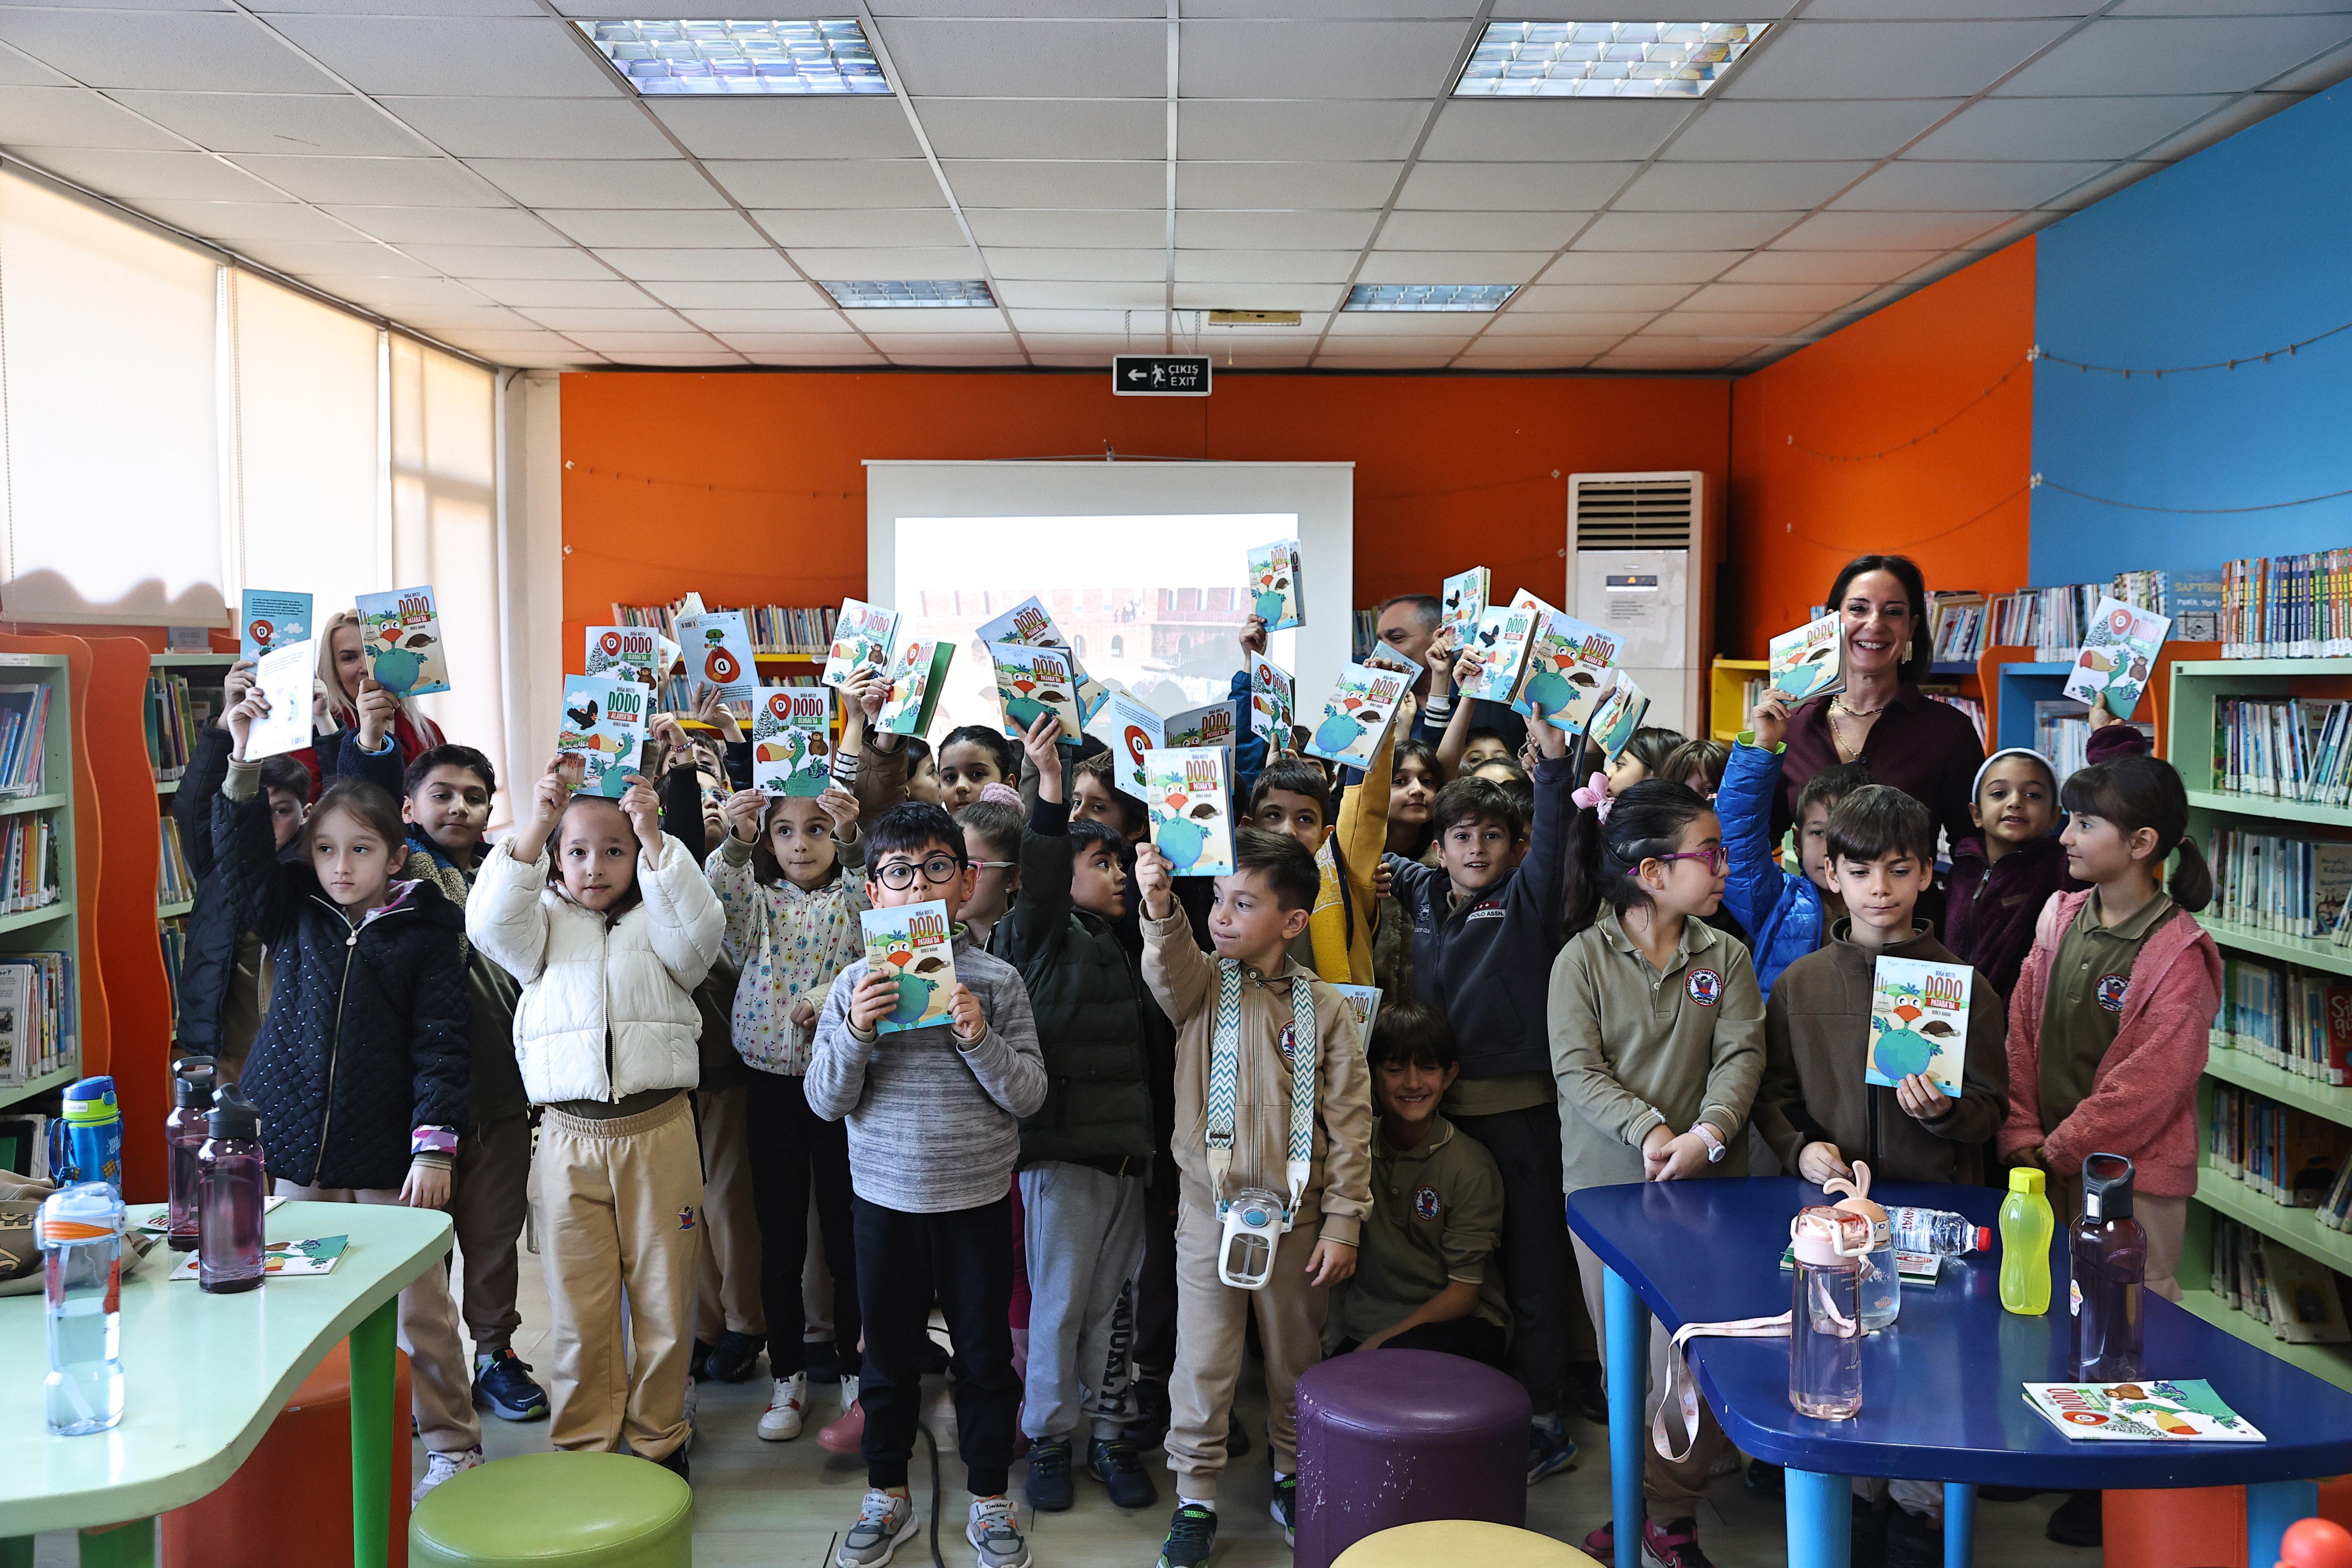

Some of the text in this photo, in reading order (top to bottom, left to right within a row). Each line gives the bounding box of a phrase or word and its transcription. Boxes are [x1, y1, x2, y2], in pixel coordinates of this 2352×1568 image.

[1168, 365, 1199, 376] ÇIKIŞ
[1171, 377, 1197, 386] EXIT
[1271, 547, 1287, 565] DODO
[1464, 575, 1477, 592] DODO
[398, 596, 430, 617] DODO
[407, 615, 427, 624] PATARA'DA
[866, 613, 889, 632] DODO
[1013, 607, 1043, 633] DODO
[1506, 617, 1528, 633] DODO
[1027, 624, 1045, 637] PATARA'DA
[1808, 621, 1834, 642] DODO
[624, 636, 652, 653] DODO
[1582, 635, 1615, 660] DODO
[917, 646, 933, 662] DODO
[1584, 654, 1604, 666] PATARA'DA
[1033, 658, 1064, 676] DODO
[1040, 675, 1061, 683] PATARA'DA
[1273, 674, 1289, 696] DODO
[1370, 678, 1400, 697] DODO
[608, 691, 641, 713] DODO
[794, 698, 823, 716] DODO
[1371, 695, 1389, 704] PATARA'DA
[611, 712, 633, 721] ALANYA'DA
[1202, 711, 1230, 733] DODO
[1206, 728, 1225, 739] PATARA'DA
[1136, 740, 1143, 751] D
[1186, 760, 1217, 781] DODO
[1193, 782, 1214, 790] PATARA'DA
[909, 914, 944, 938] DODO
[917, 936, 940, 946] PATARA'DA
[1925, 975, 1963, 1001] DODO
[1930, 998, 1956, 1010] PATARA'DA
[2046, 1388, 2093, 1410] DODO
